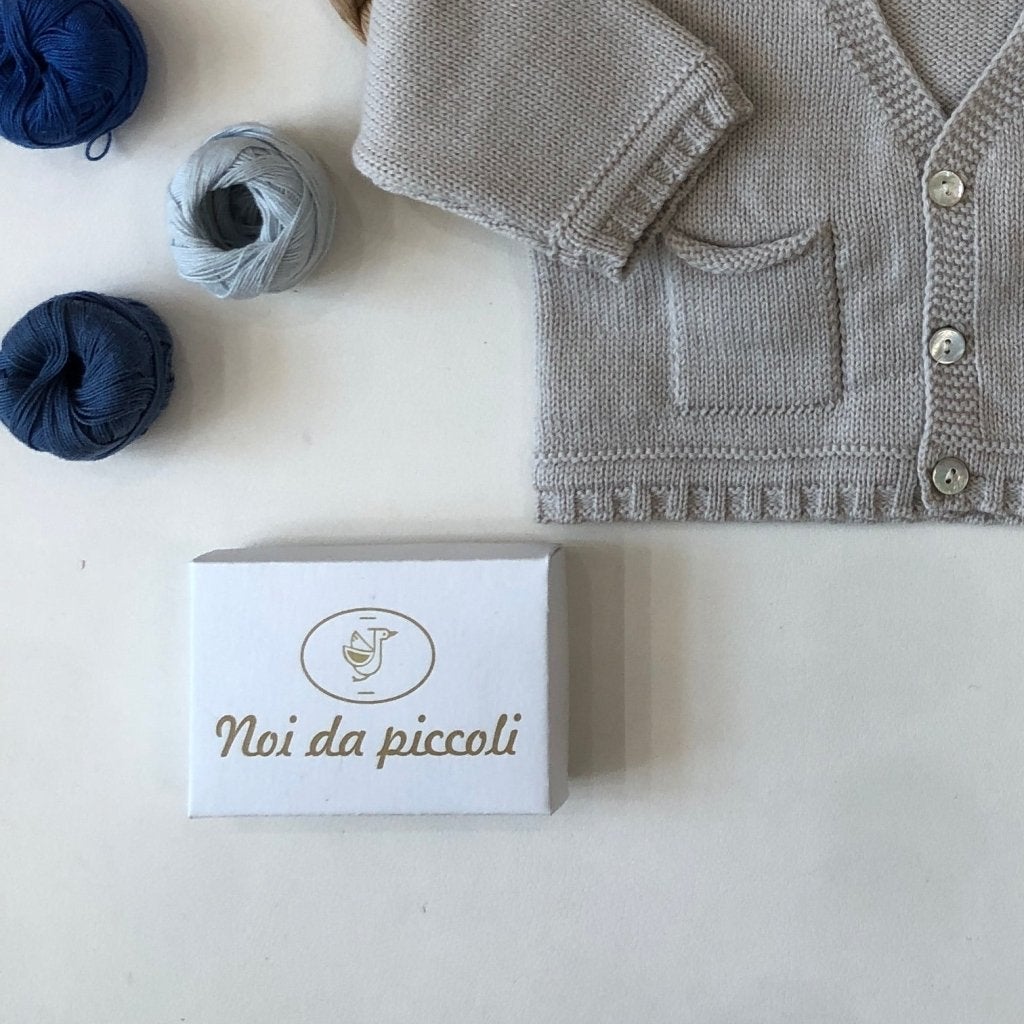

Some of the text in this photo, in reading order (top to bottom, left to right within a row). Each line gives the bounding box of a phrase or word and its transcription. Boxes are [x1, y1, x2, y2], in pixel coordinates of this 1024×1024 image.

[215, 713, 522, 770] Noi da piccoli
